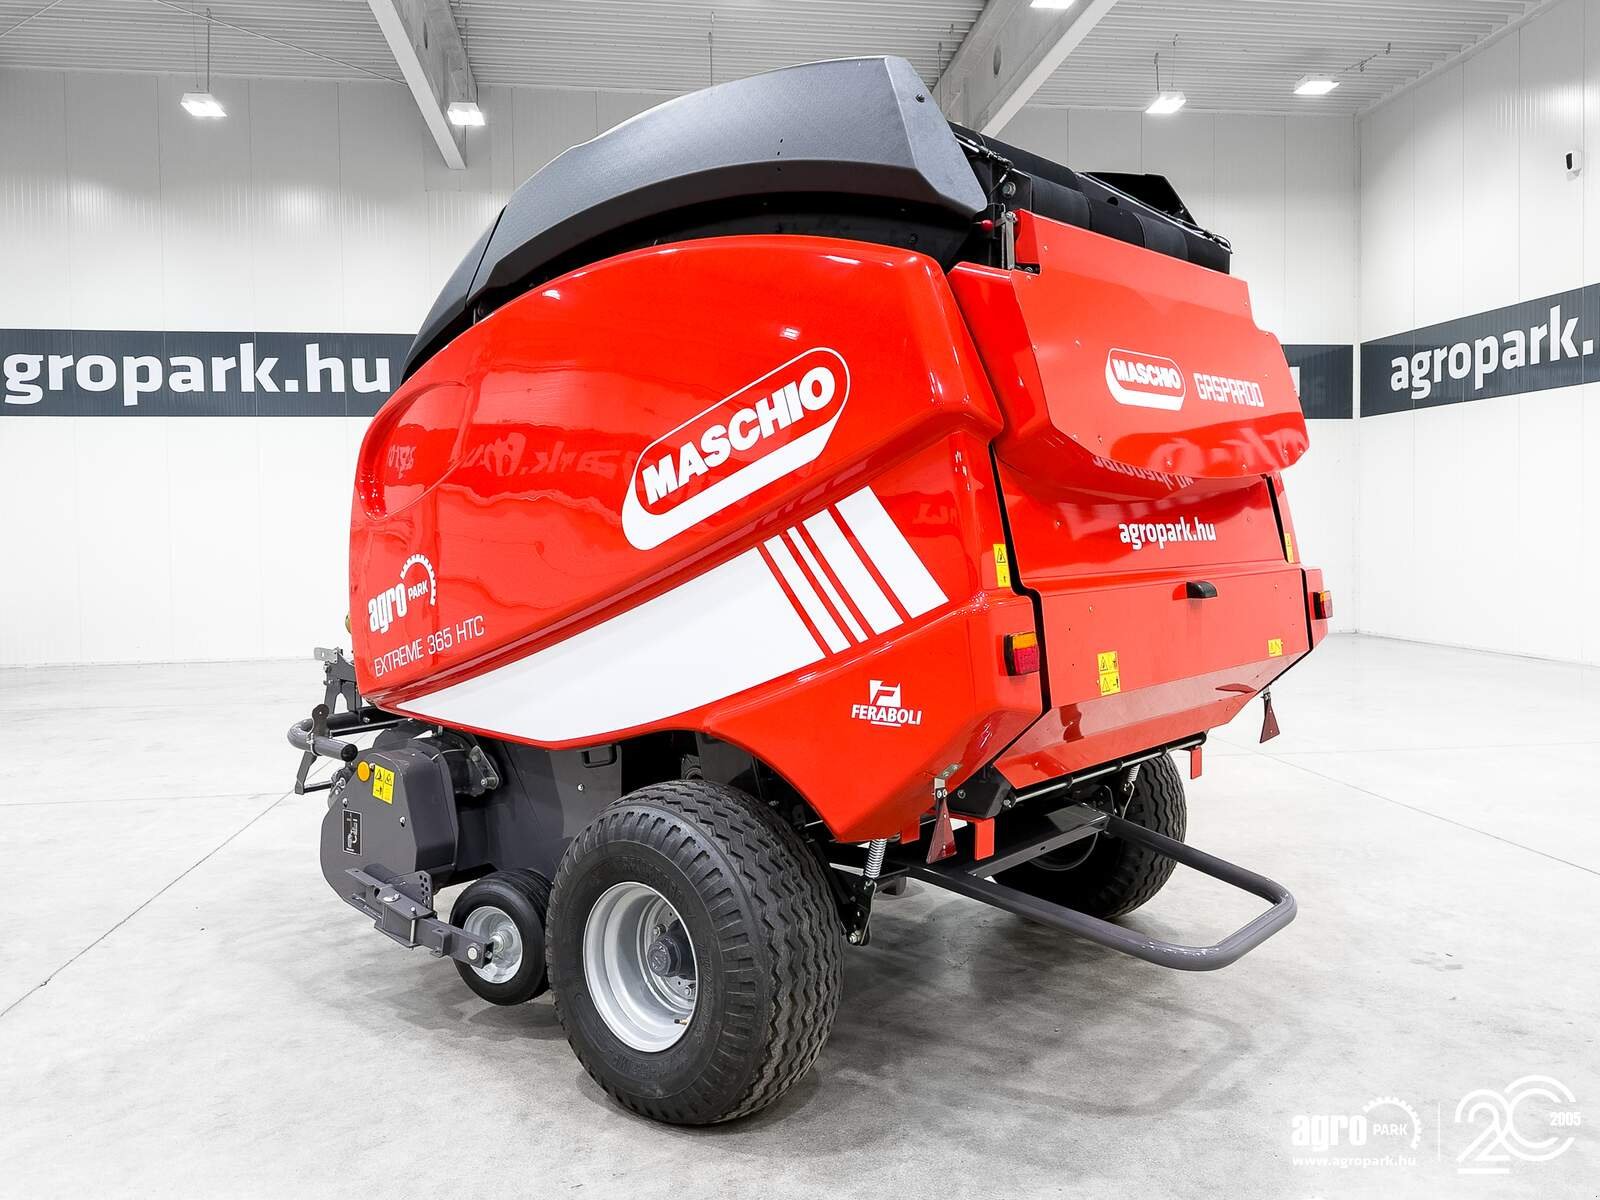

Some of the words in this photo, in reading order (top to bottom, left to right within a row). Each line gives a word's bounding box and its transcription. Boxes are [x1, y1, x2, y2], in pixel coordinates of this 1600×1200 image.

[2, 342, 391, 407] gropark.hu
[1390, 304, 1594, 400] agropark.
[1112, 359, 1182, 389] MASCHIO
[1193, 373, 1265, 408] GASPARDO
[642, 366, 836, 505] MASCHIO
[1118, 516, 1217, 550] agropark.hu
[367, 582, 407, 634] agro
[407, 579, 429, 601] PARK
[374, 638, 424, 677] EXTREME
[427, 627, 453, 655] 365
[455, 615, 485, 644] HTC
[851, 703, 922, 726] FERABOLI
